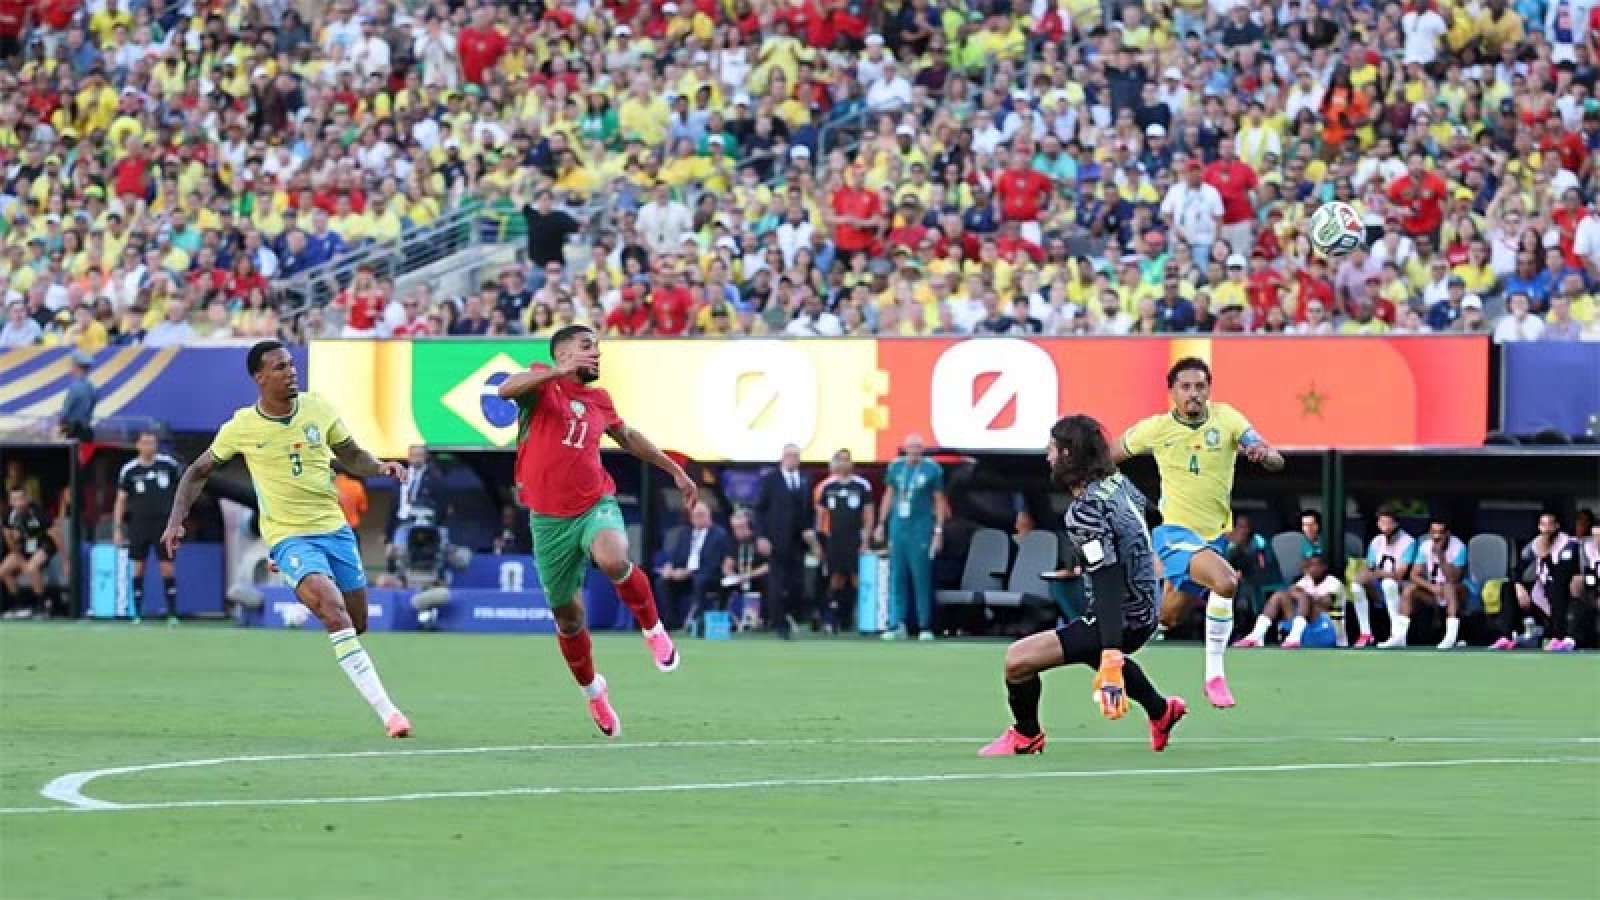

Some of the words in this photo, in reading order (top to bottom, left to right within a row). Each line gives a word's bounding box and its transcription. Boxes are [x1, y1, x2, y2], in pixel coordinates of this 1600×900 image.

[697, 338, 819, 461] 0
[931, 338, 1059, 450] 0
[561, 419, 589, 449] 11
[289, 453, 303, 477] 3
[1188, 454, 1200, 477] 4
